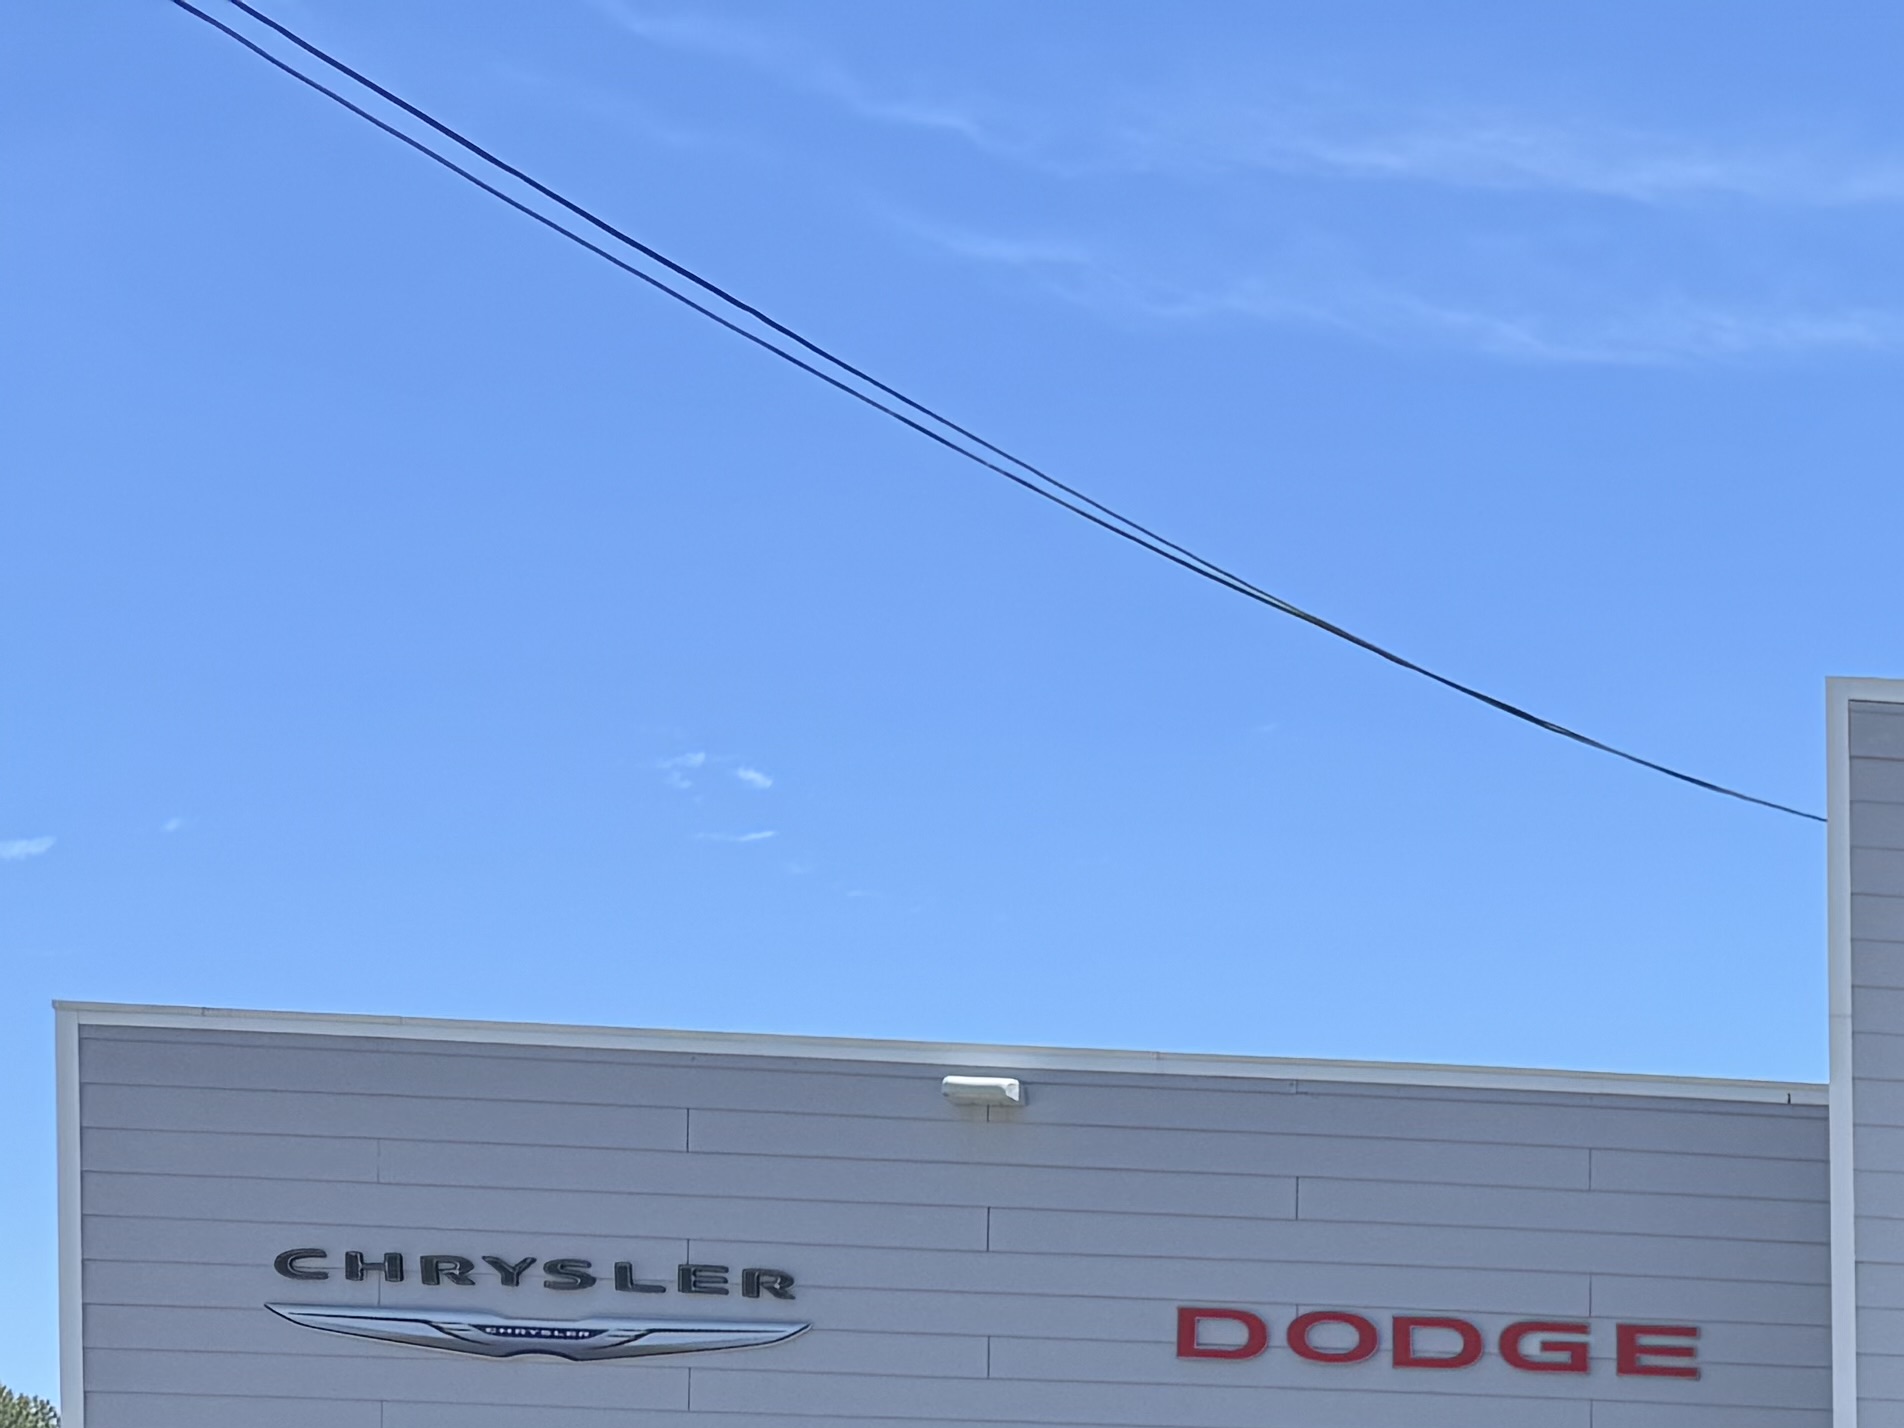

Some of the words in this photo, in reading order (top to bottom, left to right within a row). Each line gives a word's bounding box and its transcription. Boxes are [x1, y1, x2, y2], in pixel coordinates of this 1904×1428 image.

[273, 1248, 796, 1299] CHRYSLER
[485, 1326, 590, 1338] CHRYSLER
[1176, 1306, 1700, 1381] DODGE
